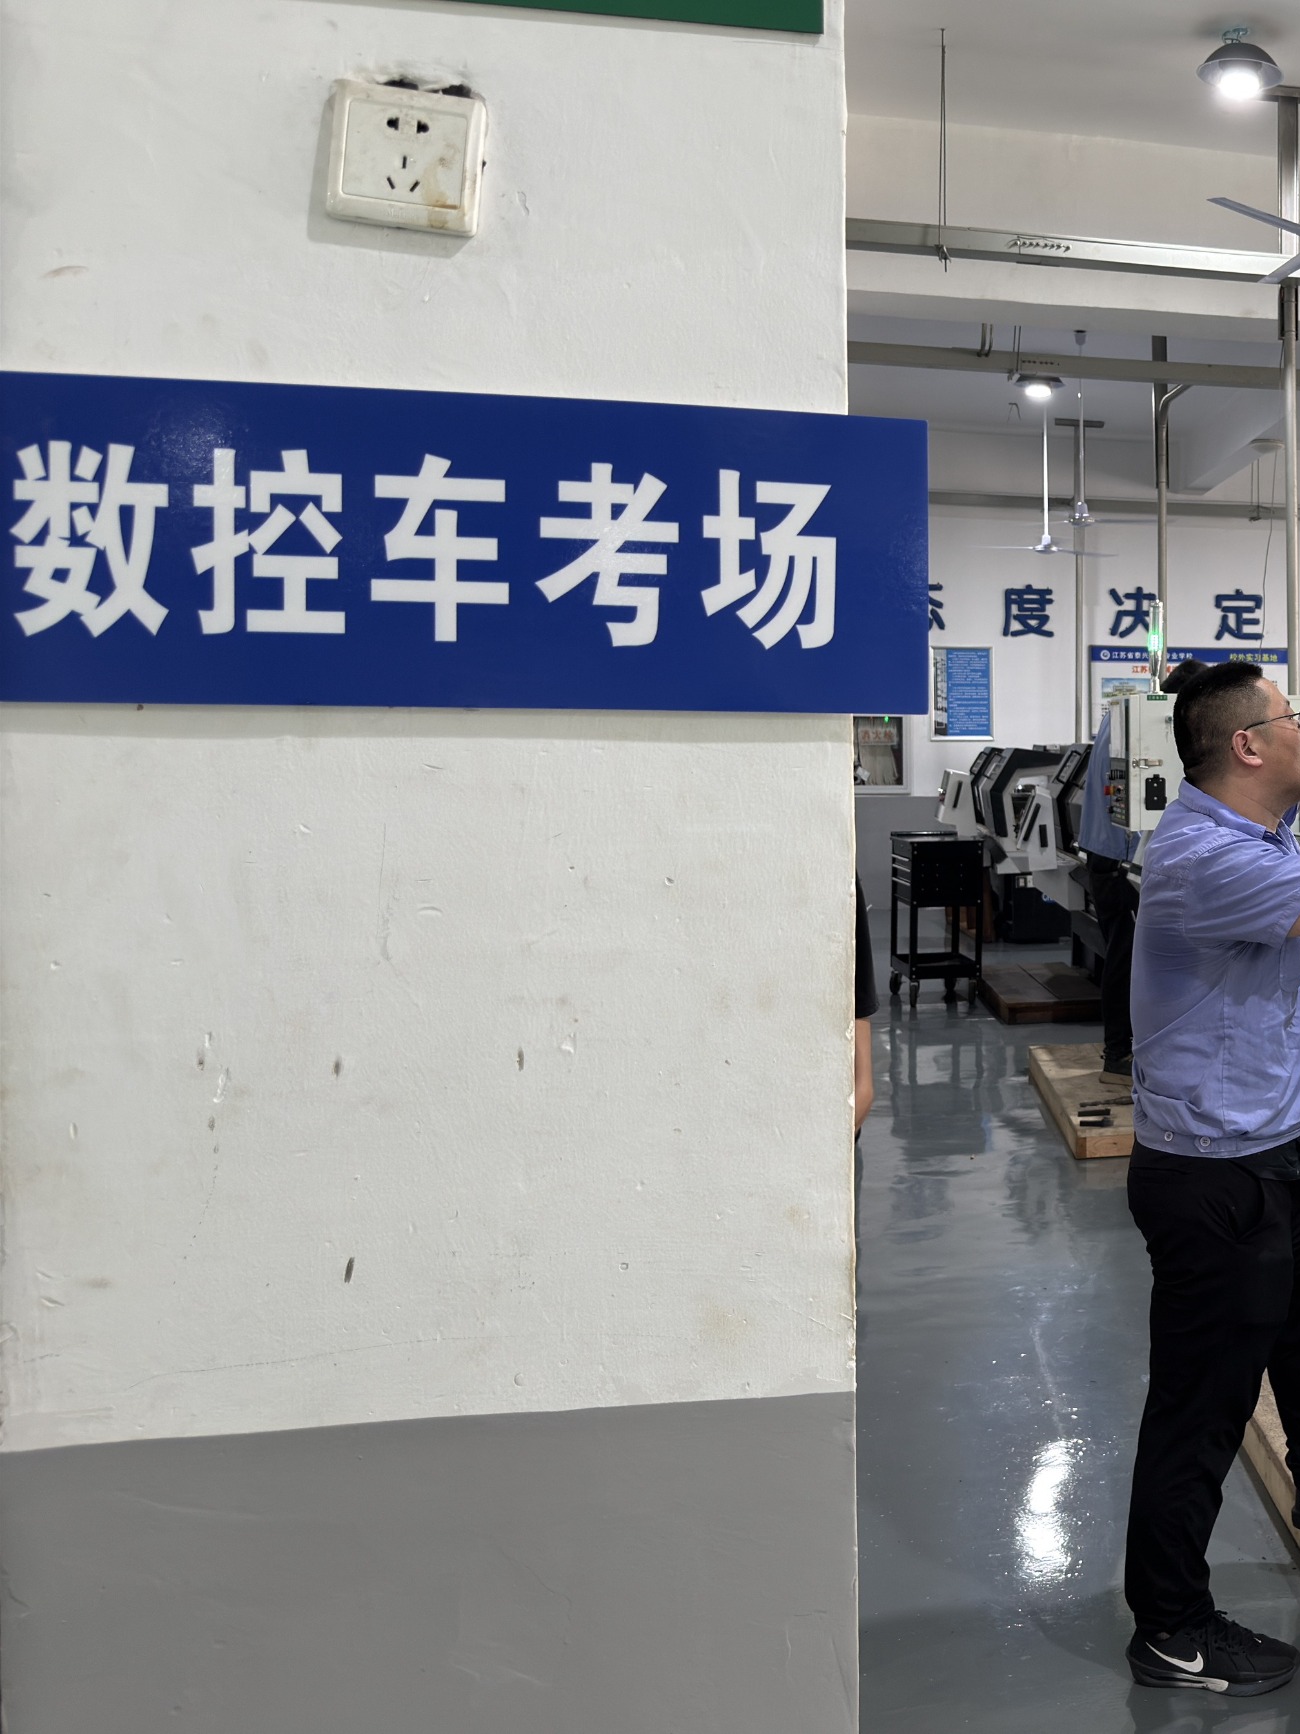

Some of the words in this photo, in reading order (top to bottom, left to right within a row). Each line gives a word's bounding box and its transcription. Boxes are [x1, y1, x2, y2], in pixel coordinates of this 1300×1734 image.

[10, 439, 837, 651] 数控车考场
